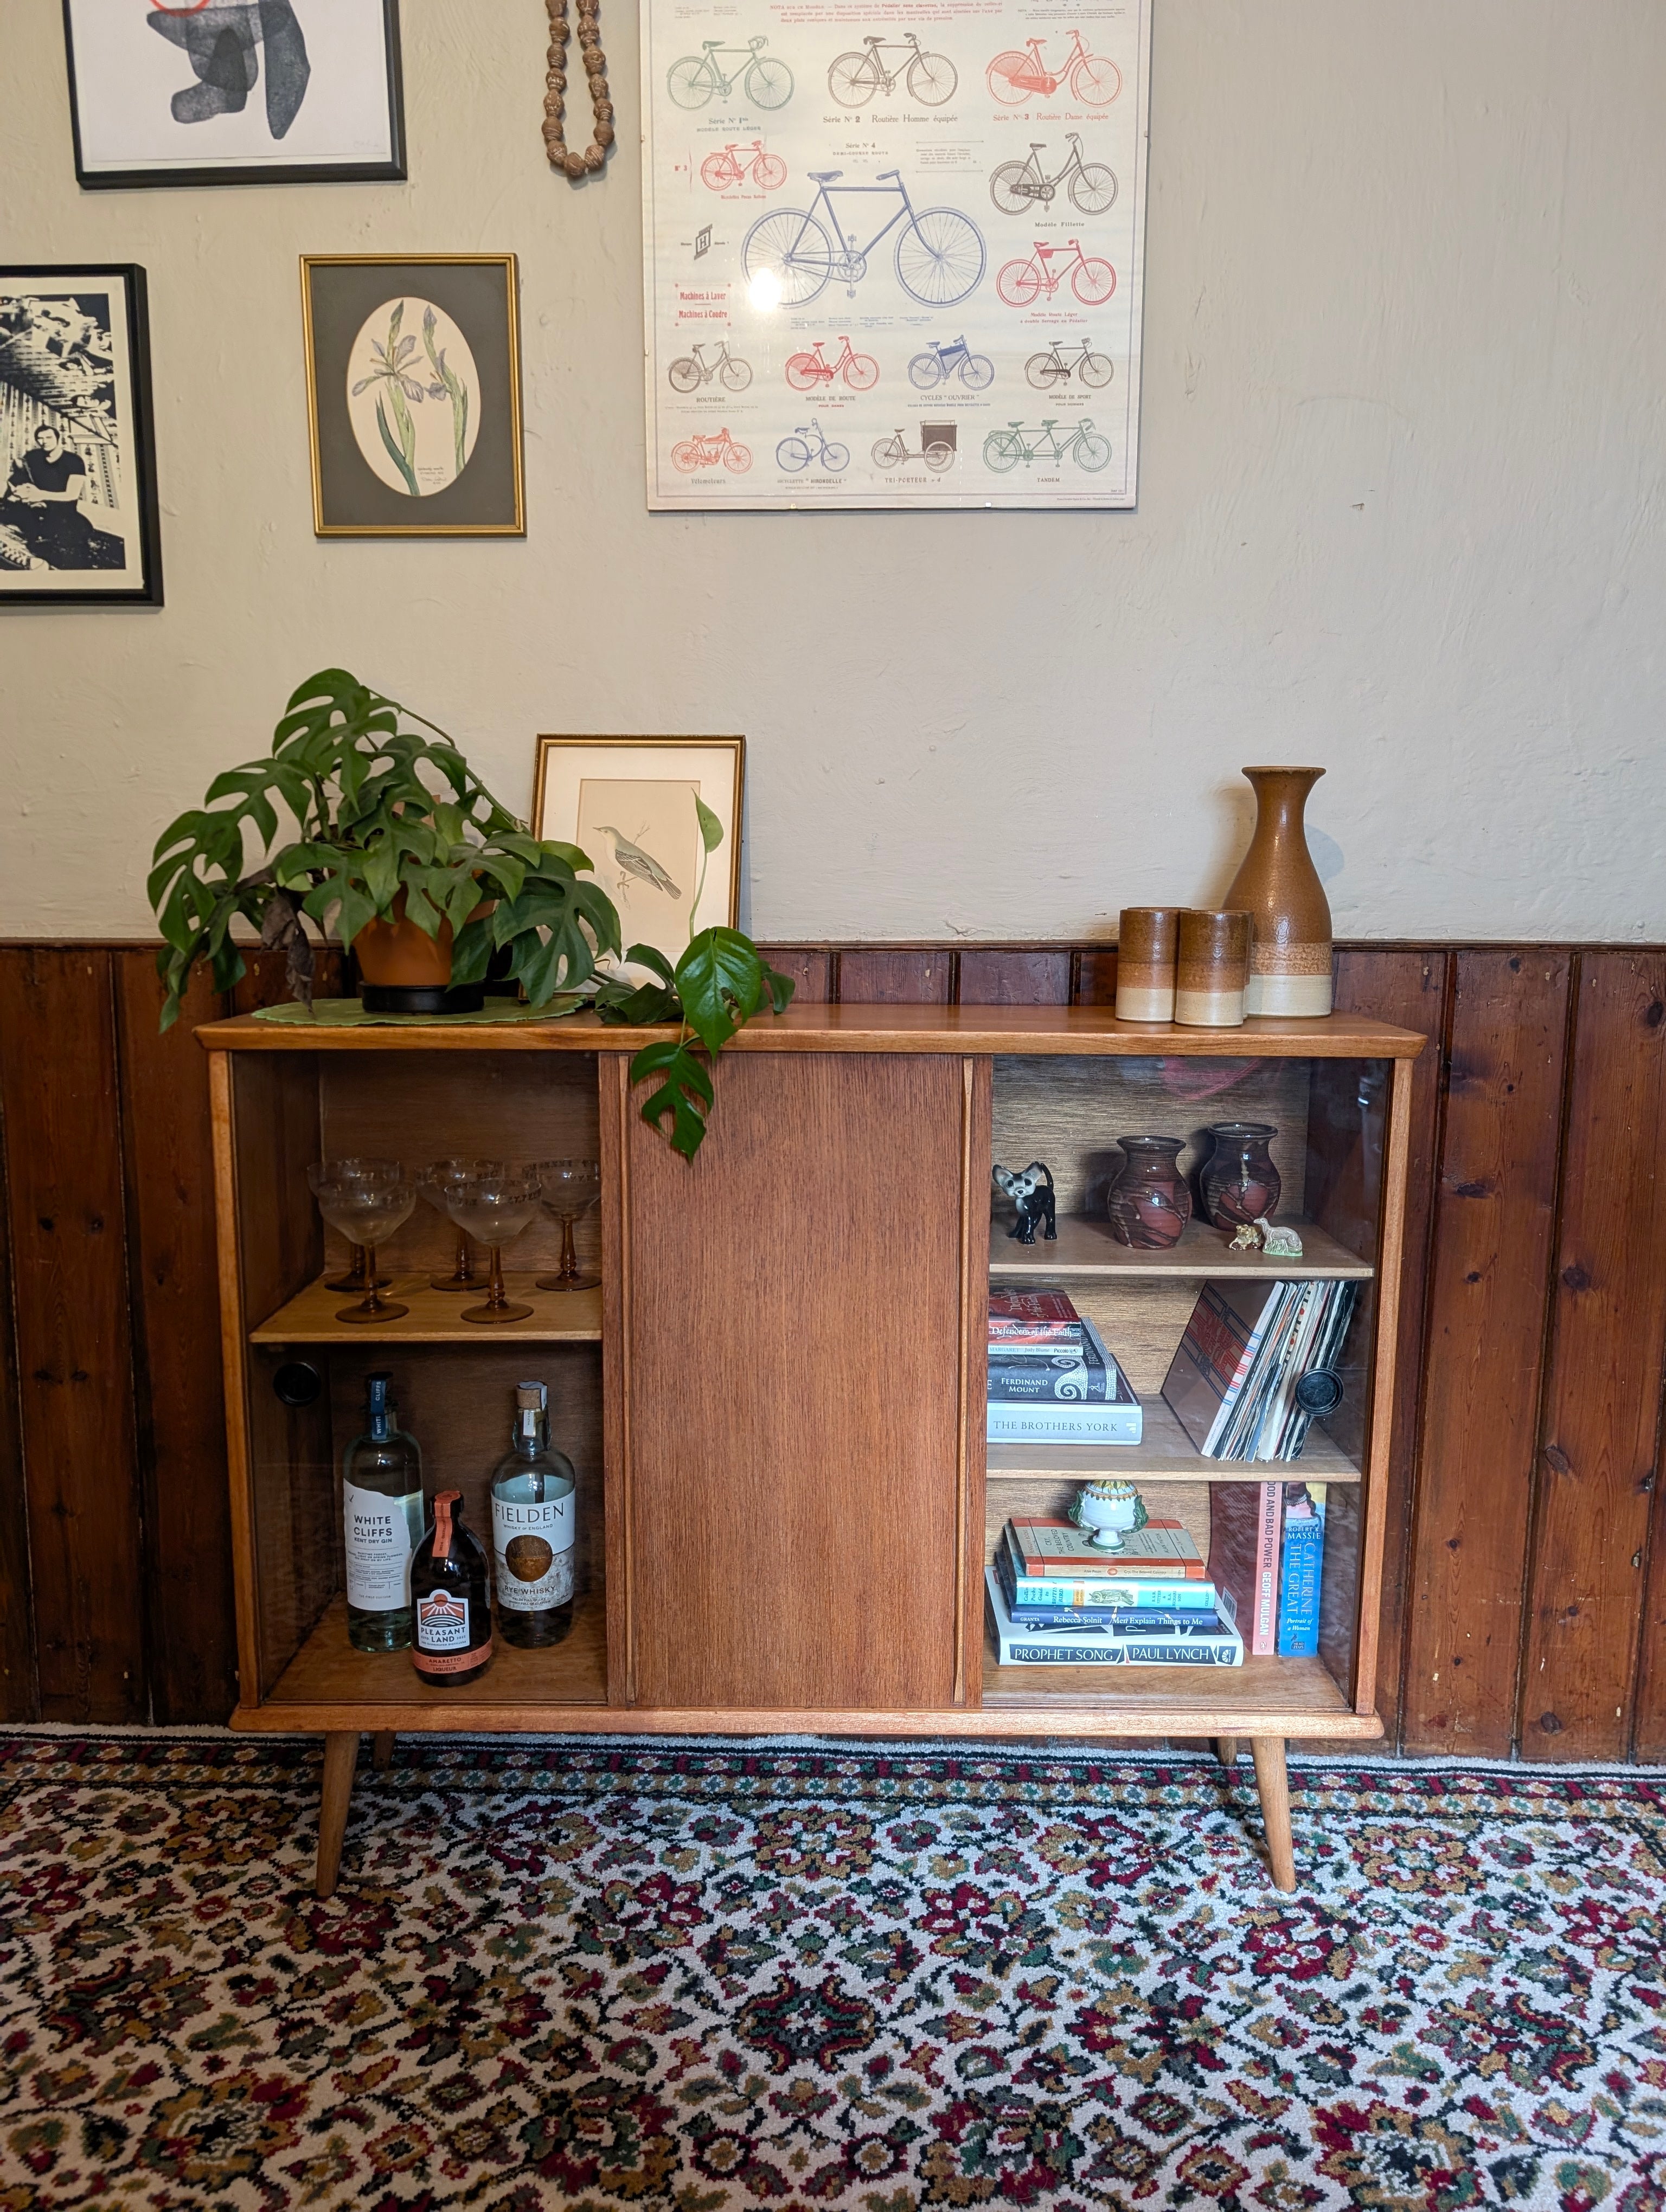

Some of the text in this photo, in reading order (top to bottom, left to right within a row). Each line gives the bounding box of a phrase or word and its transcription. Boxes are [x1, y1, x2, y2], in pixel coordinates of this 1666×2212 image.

[872, 114, 899, 123] Routière
[903, 114, 930, 122] Homme
[933, 115, 958, 124] équipée
[700, 235, 707, 249] H
[680, 292, 704, 300] Machines
[711, 292, 726, 300] Laver
[679, 310, 703, 318] Machines
[709, 310, 727, 318] Coudre
[991, 1323, 1032, 1339] Defenders
[1001, 1378, 1048, 1386] FERDINAND
[994, 1420, 1118, 1432] THE BROTHERS YORK
[495, 1502, 563, 1523] FIELDEN
[354, 1514, 391, 1525] WHITE
[1263, 1482, 1276, 1568] OOD AND BAD POWER
[354, 1527, 392, 1538] CLIFFS
[1052, 1528, 1067, 1554] THE BELOVED
[1061, 1532, 1074, 1552] COUNTRY
[1160, 1543, 1170, 1557] ALAN
[1286, 1544, 1302, 1615] THE GREAT
[1300, 1542, 1316, 1616] CATHERINE
[504, 1585, 556, 1595] RYE WHISKY
[1259, 1572, 1272, 1636] GEOFF MULGAN
[1157, 1617, 1181, 1626] Things
[420, 1626, 465, 1636] PLEASANT
[1014, 1648, 1209, 1661] PROPHET SONG PAUL LYNCH
